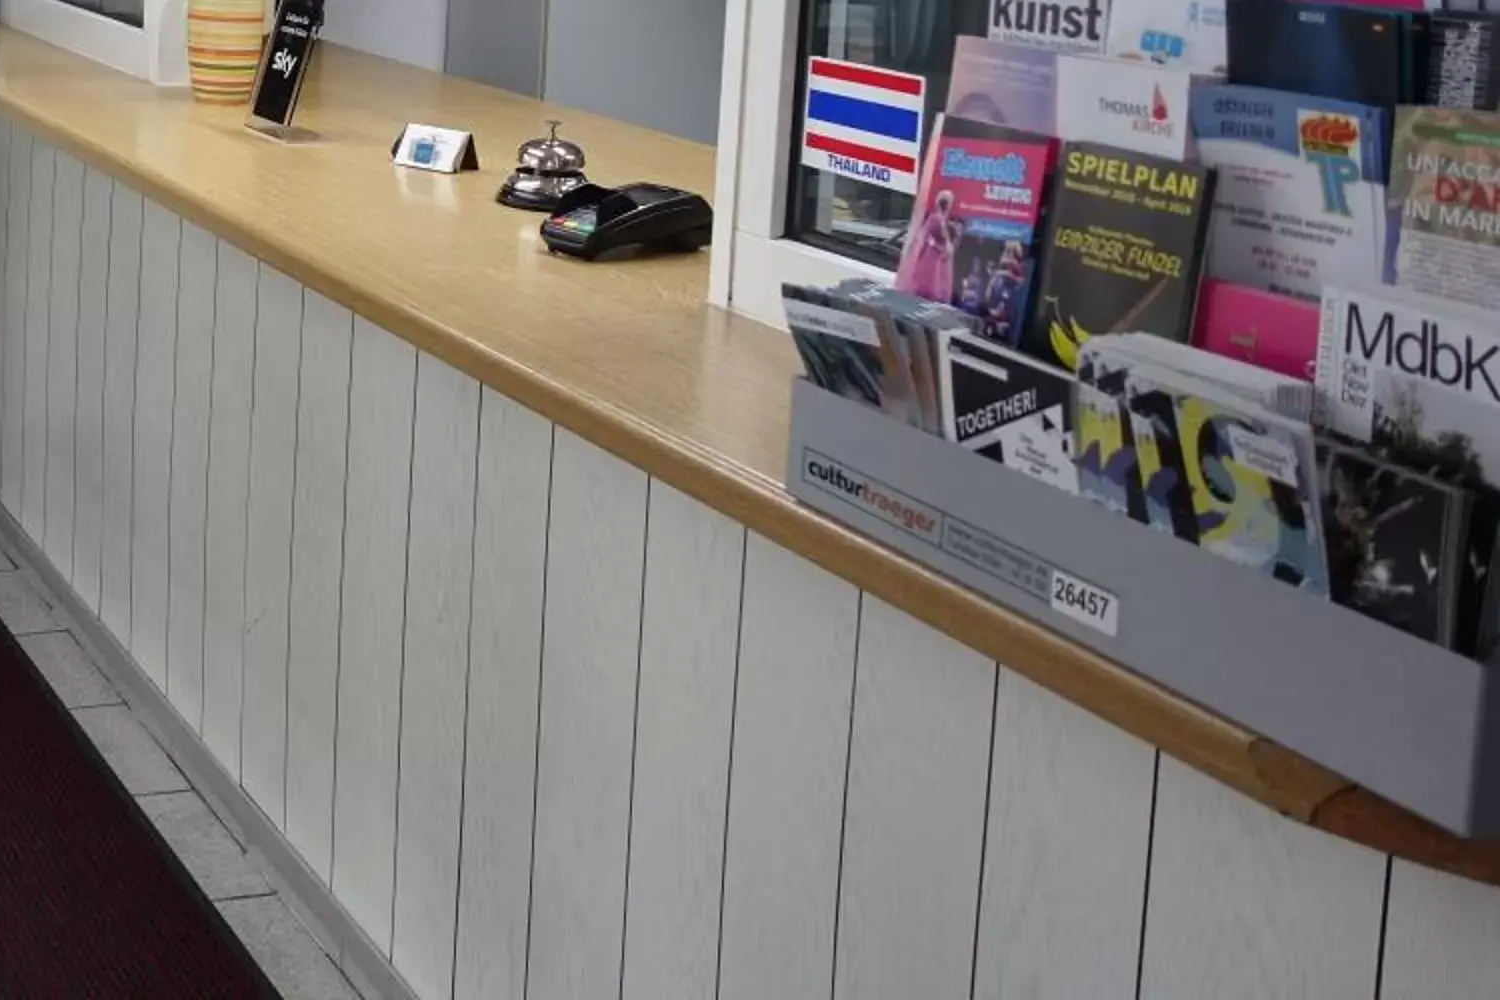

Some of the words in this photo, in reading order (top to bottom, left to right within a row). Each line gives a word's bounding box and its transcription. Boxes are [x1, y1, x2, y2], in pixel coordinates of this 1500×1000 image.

[272, 47, 298, 80] sky
[1098, 96, 1149, 117] THOMAS
[827, 153, 891, 183] THAILAND
[1066, 151, 1198, 199] SPIELPLAN
[1404, 198, 1430, 222] IN
[1346, 302, 1500, 402] MdbK
[957, 387, 1037, 438] TOGETHER!
[807, 458, 936, 534] culturtraeger
[1054, 578, 1110, 622] 26457
